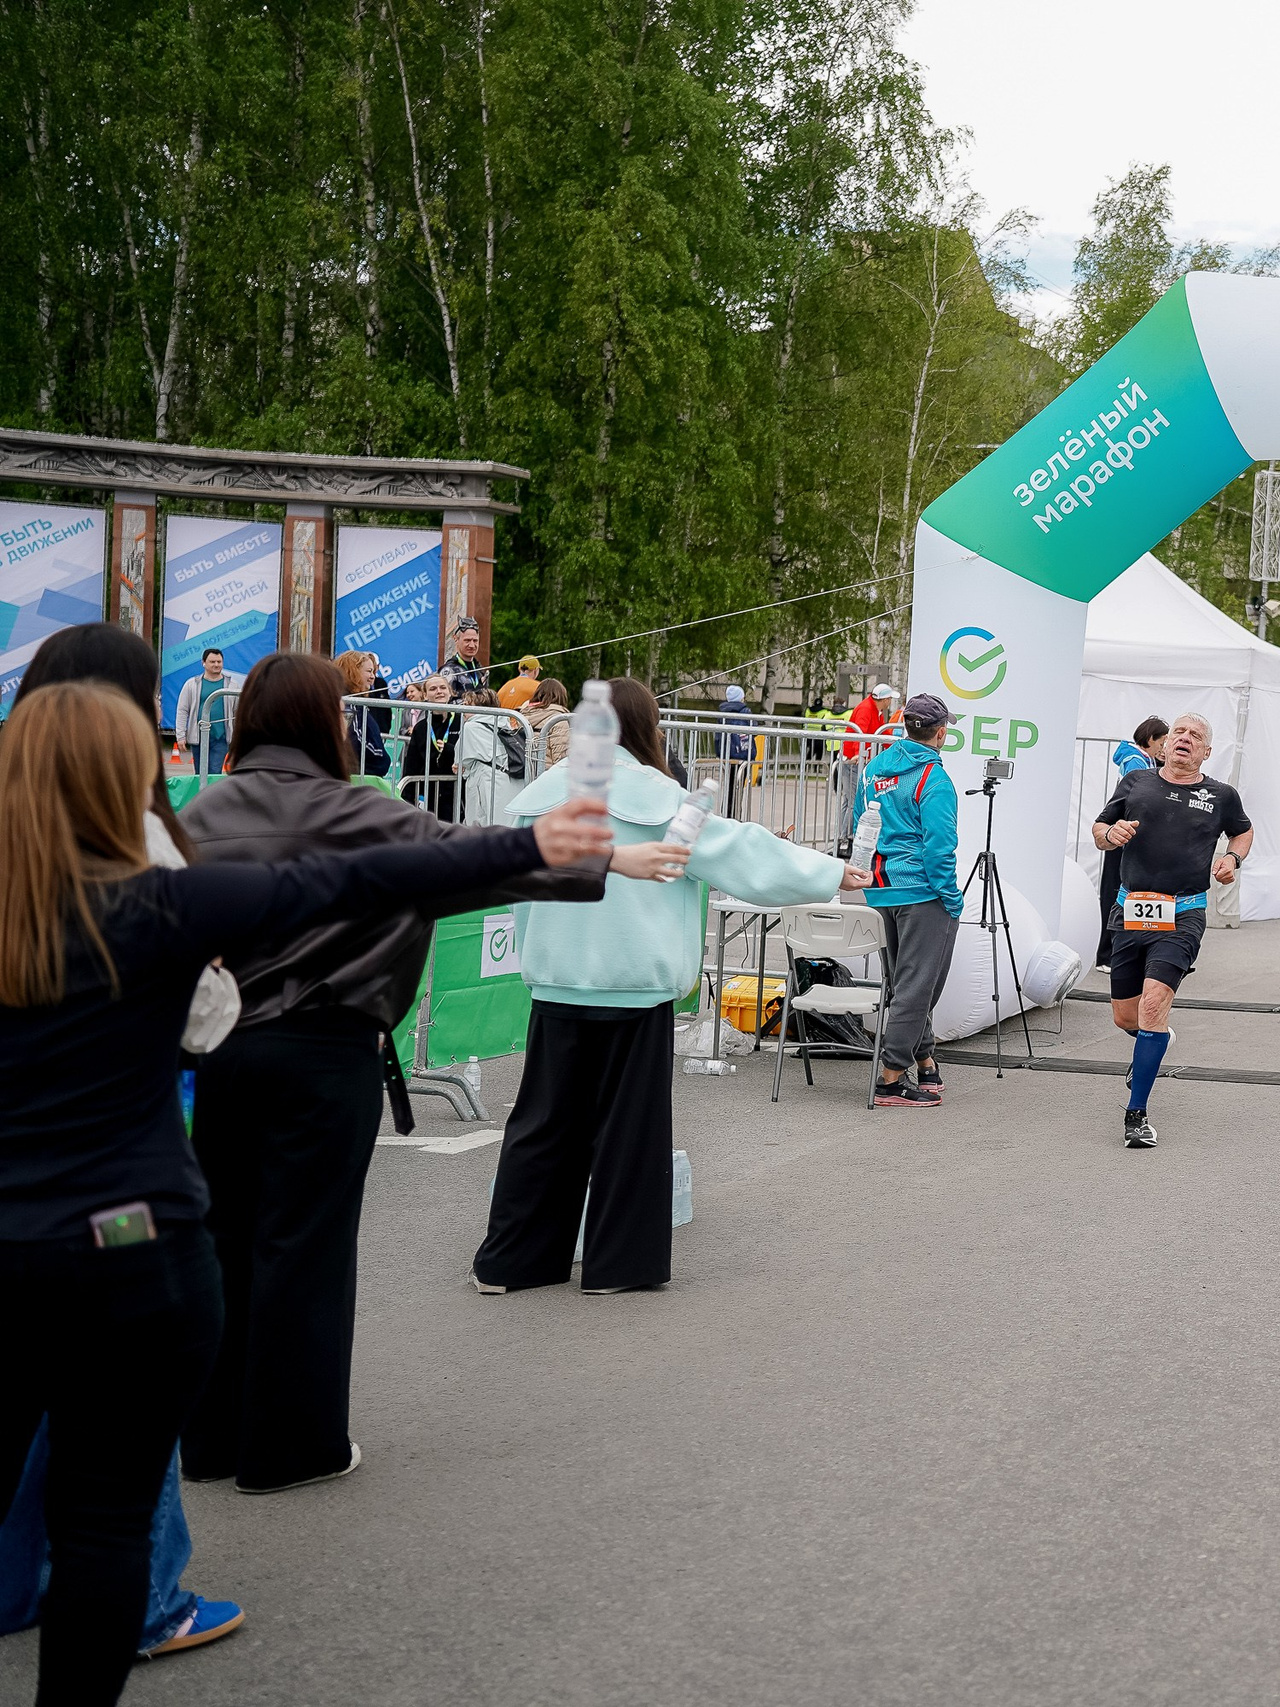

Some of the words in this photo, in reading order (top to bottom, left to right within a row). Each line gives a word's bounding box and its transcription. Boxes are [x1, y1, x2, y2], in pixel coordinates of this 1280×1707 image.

[1012, 376, 1149, 507] зелёный
[1032, 407, 1171, 534] марафон
[0, 518, 53, 547] БЫТЬ
[7, 517, 95, 566] ДВИЖЕНИИ
[174, 558, 214, 583] БЫТЬ
[214, 531, 272, 565] ВМЕСТЕ
[345, 540, 418, 584] ФЕСТИВАЛЬ
[204, 579, 244, 602] БЫТЬ
[204, 579, 269, 617] РОССИЕЙ
[349, 571, 432, 627] ДВИЖЕНИЕ
[343, 592, 434, 651] ПЕРВЫХ
[940, 713, 1039, 759] БЕР
[876, 777, 896, 790] TIME
[1134, 903, 1163, 919] 321
